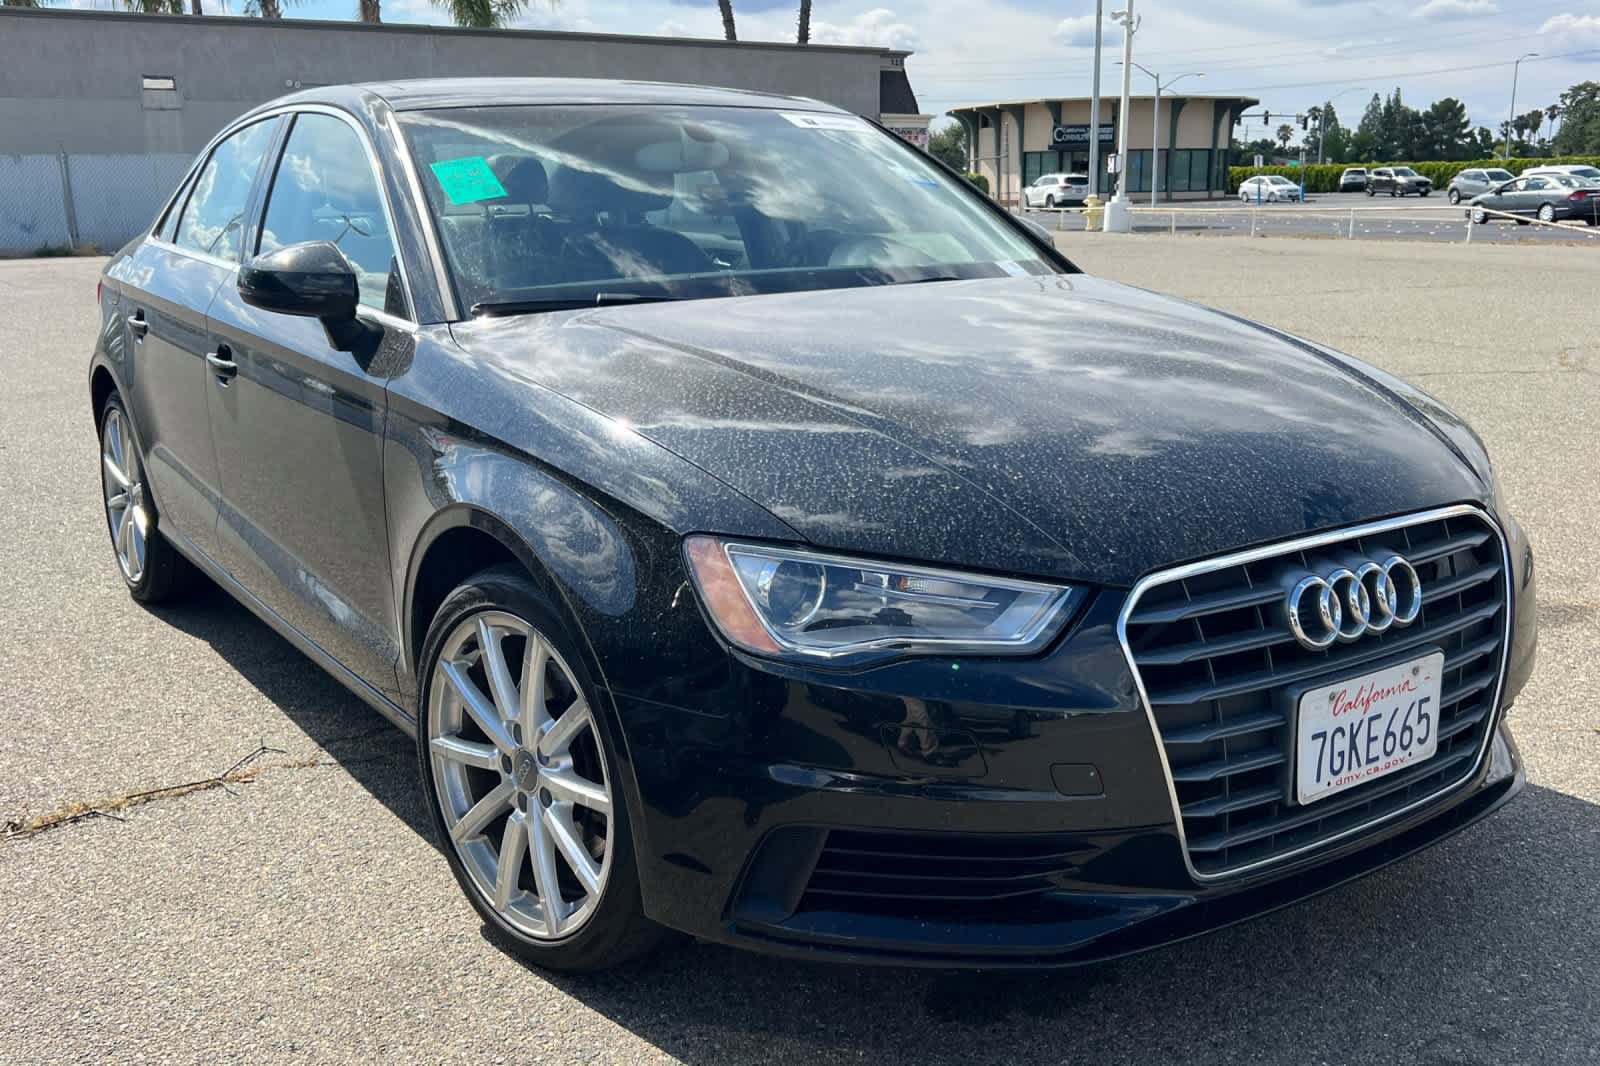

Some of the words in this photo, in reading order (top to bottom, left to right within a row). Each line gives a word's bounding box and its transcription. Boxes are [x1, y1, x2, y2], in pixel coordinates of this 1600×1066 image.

[1332, 679, 1418, 717] California
[1311, 696, 1431, 783] 7GKE665
[1335, 756, 1406, 786] dmv.ca.gov
